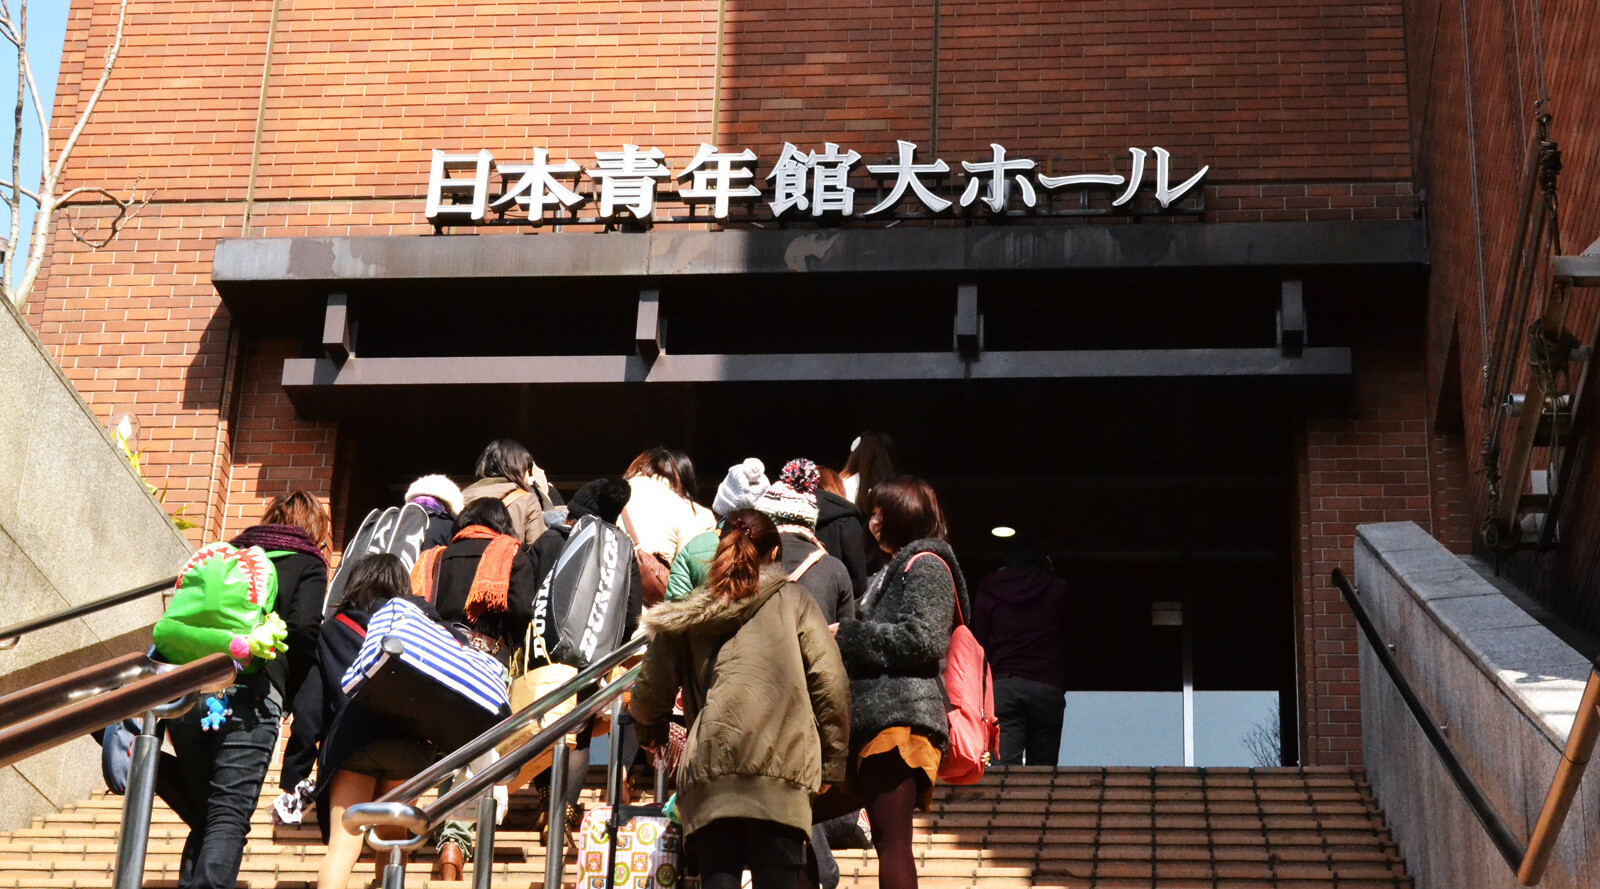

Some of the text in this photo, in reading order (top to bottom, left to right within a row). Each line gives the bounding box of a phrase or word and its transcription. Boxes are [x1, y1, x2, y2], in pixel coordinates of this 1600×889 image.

[425, 140, 1209, 221] 日本青年館大ホール
